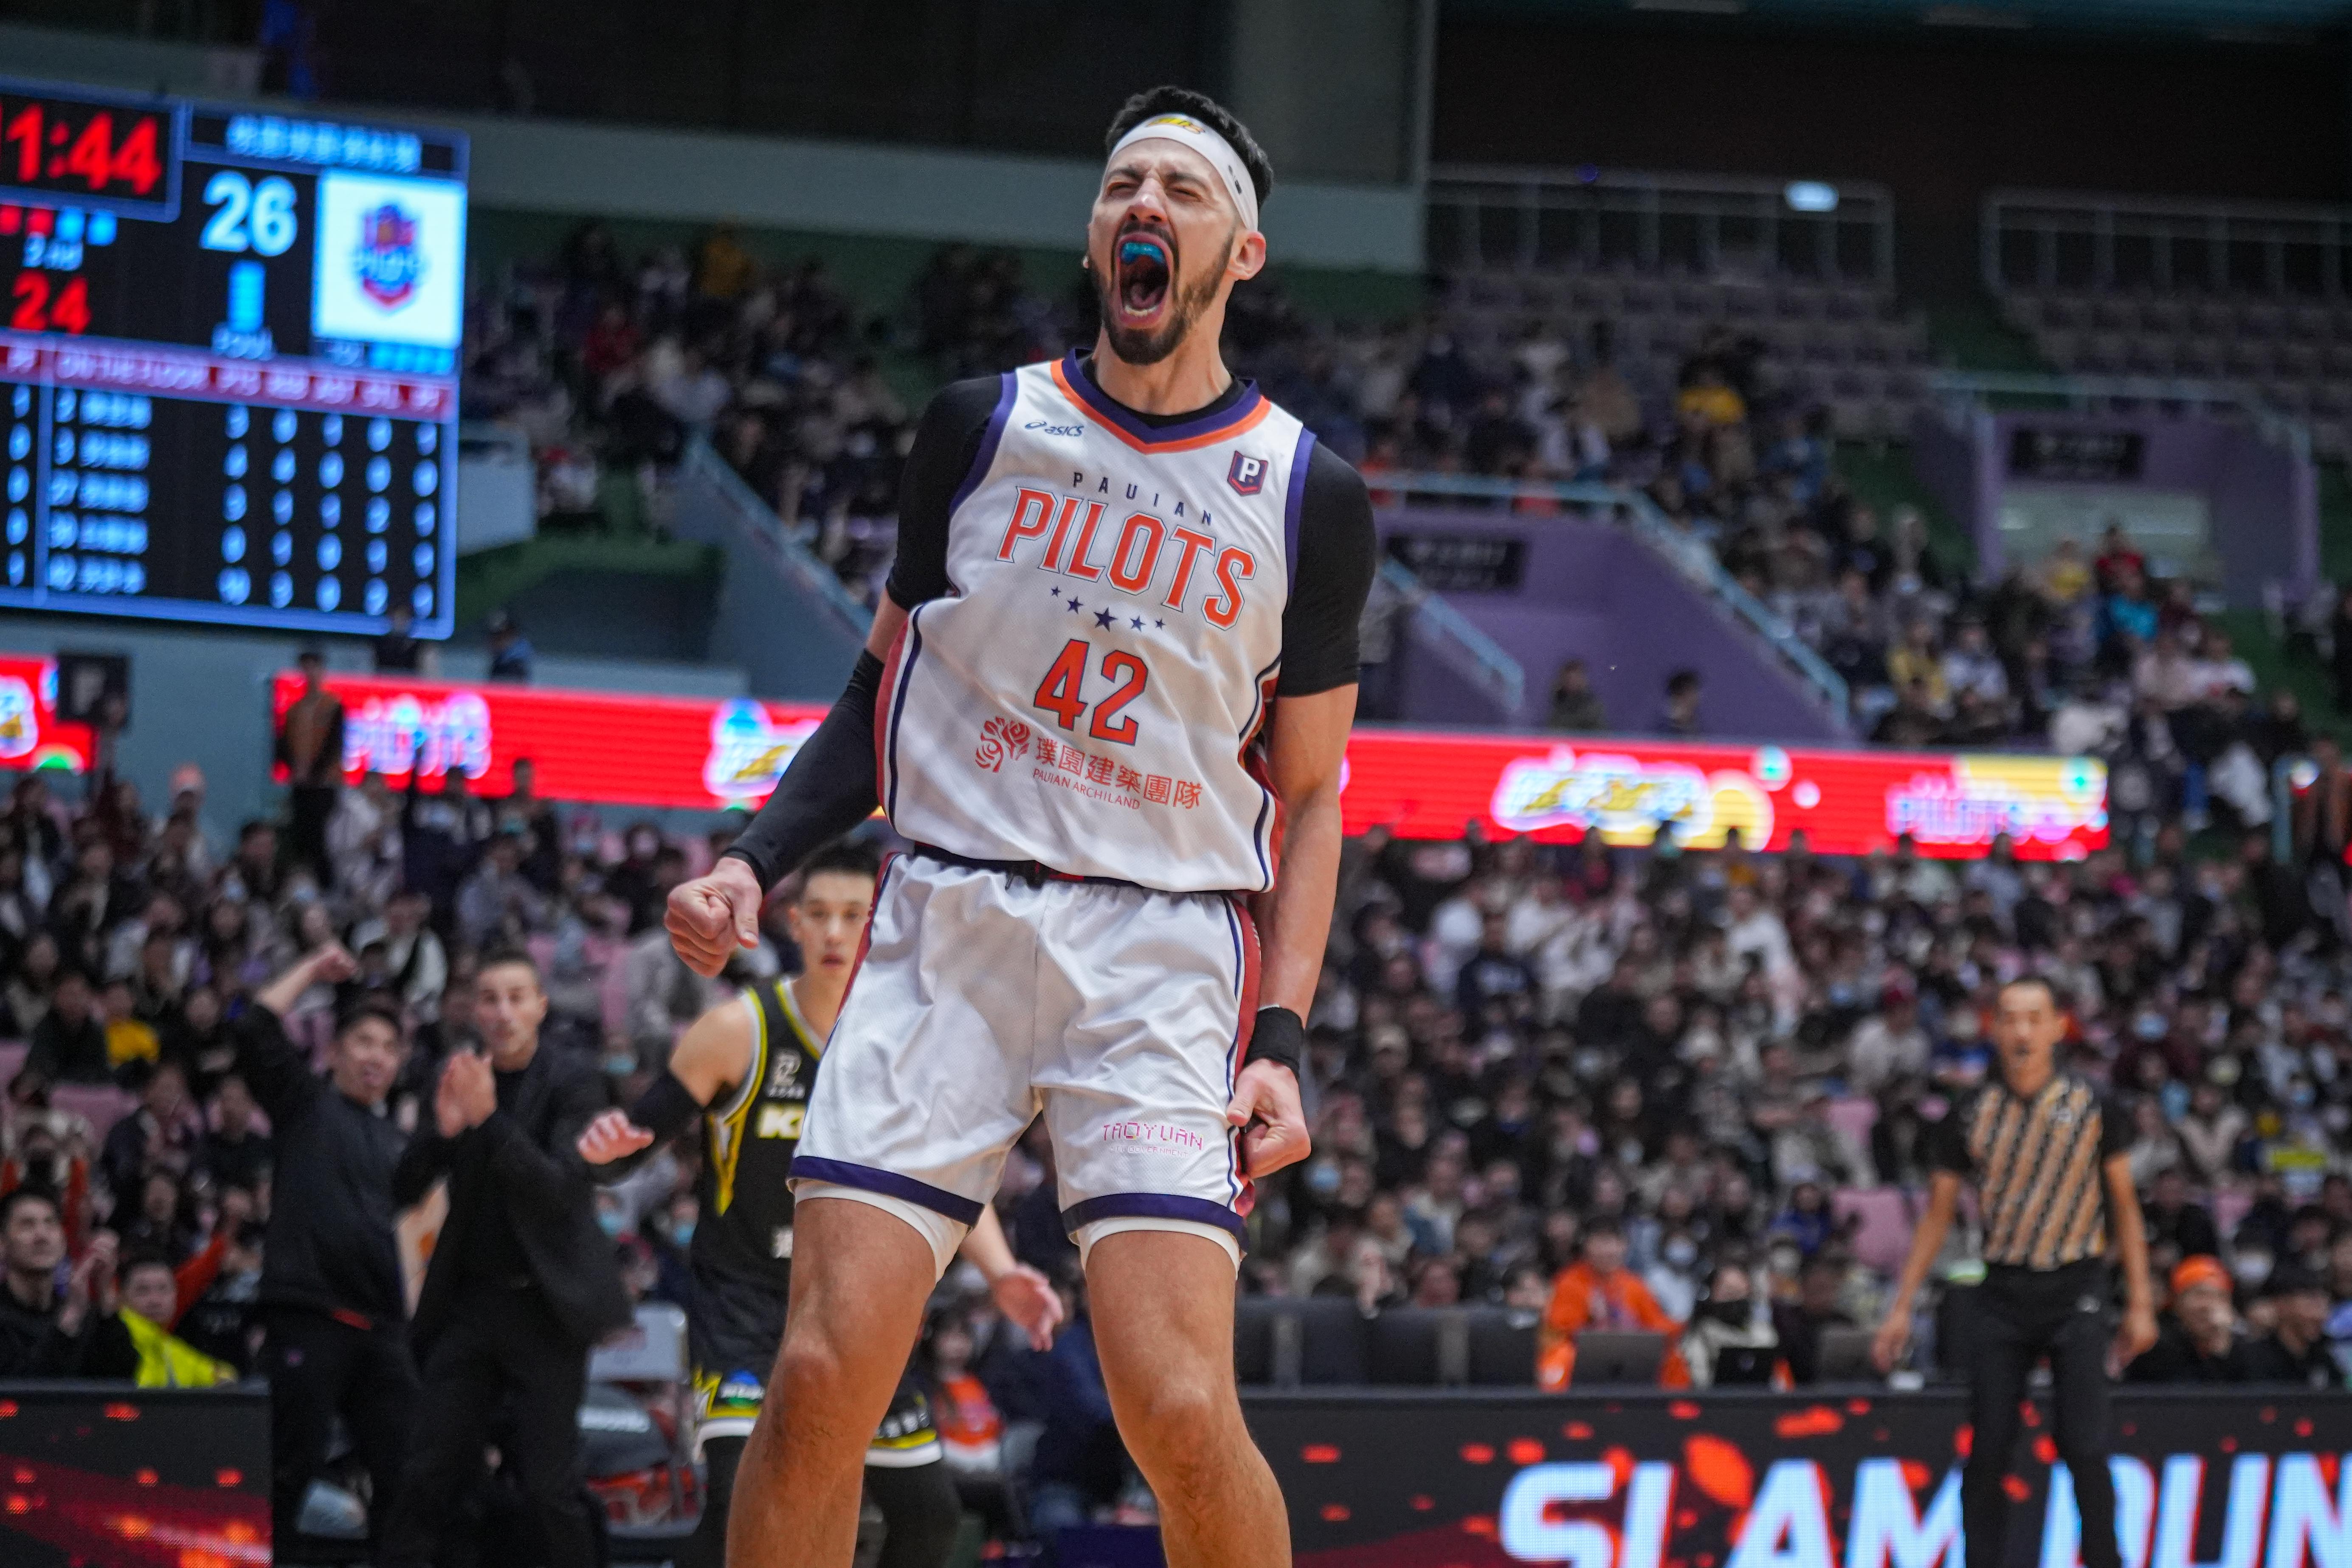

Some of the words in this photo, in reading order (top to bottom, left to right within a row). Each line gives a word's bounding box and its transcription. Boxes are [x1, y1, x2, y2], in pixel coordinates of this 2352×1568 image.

[0, 101, 162, 195] 1:44
[200, 170, 299, 257] 26
[11, 268, 93, 335] 24
[1044, 425, 1084, 437] asics
[1072, 471, 1212, 526] PAUIAN
[1239, 456, 1261, 483] P
[995, 485, 1258, 631] PILOTS
[1033, 638, 1149, 746] 42
[1032, 768, 1070, 789] PAUIAN
[1073, 781, 1141, 810] ARCHILAND
[1035, 736, 1203, 810] 璞園建築團隊
[1103, 1122, 1203, 1151] TAOYUAN
[1499, 1459, 1965, 1568] SLAM
